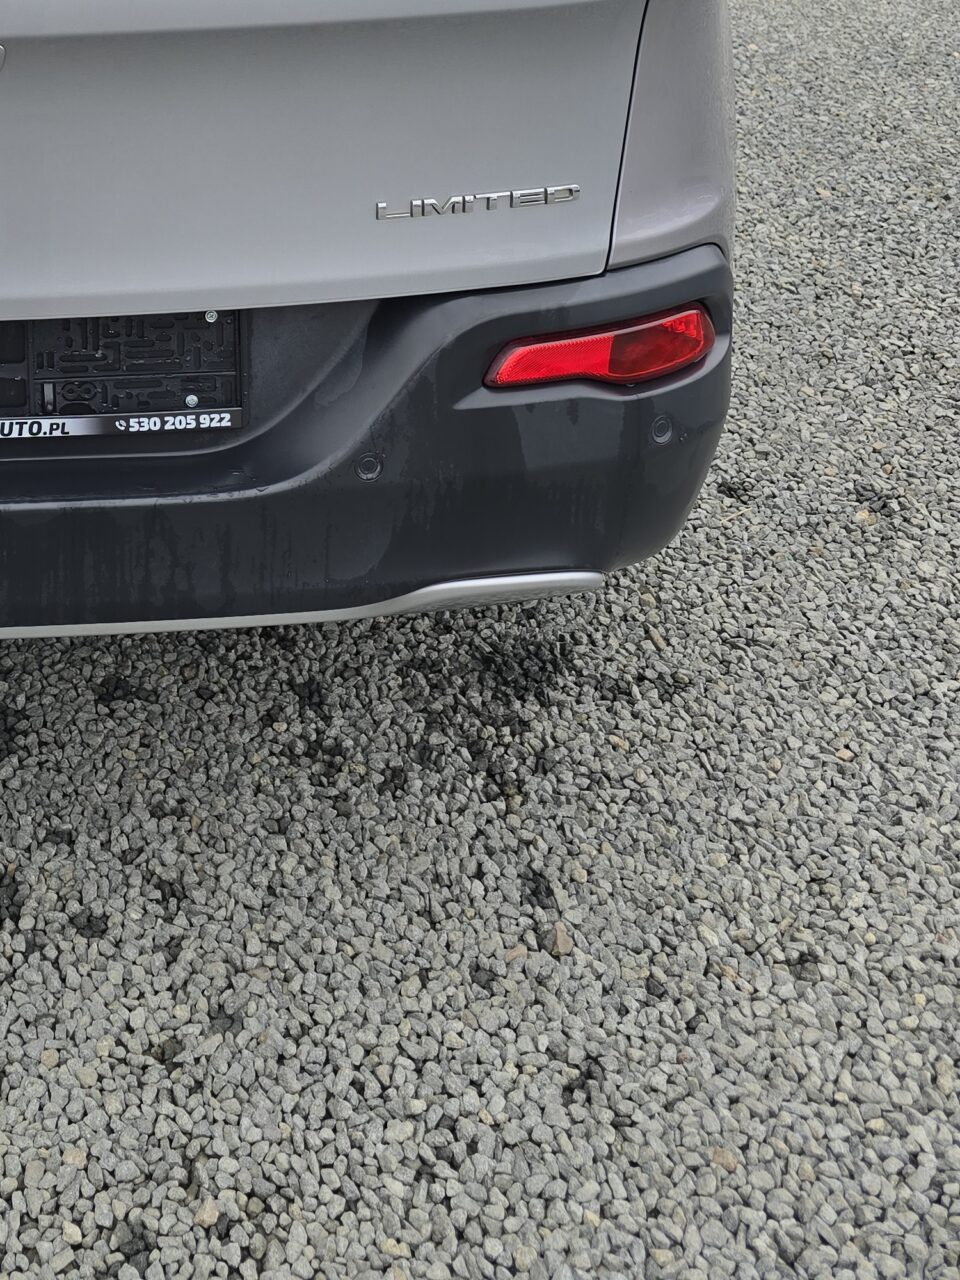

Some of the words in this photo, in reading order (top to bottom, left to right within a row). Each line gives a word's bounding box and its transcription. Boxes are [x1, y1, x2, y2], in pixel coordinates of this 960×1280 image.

[376, 184, 581, 220] LIMITED
[128, 417, 159, 432] 530
[163, 415, 196, 430] 205
[199, 413, 232, 428] 922
